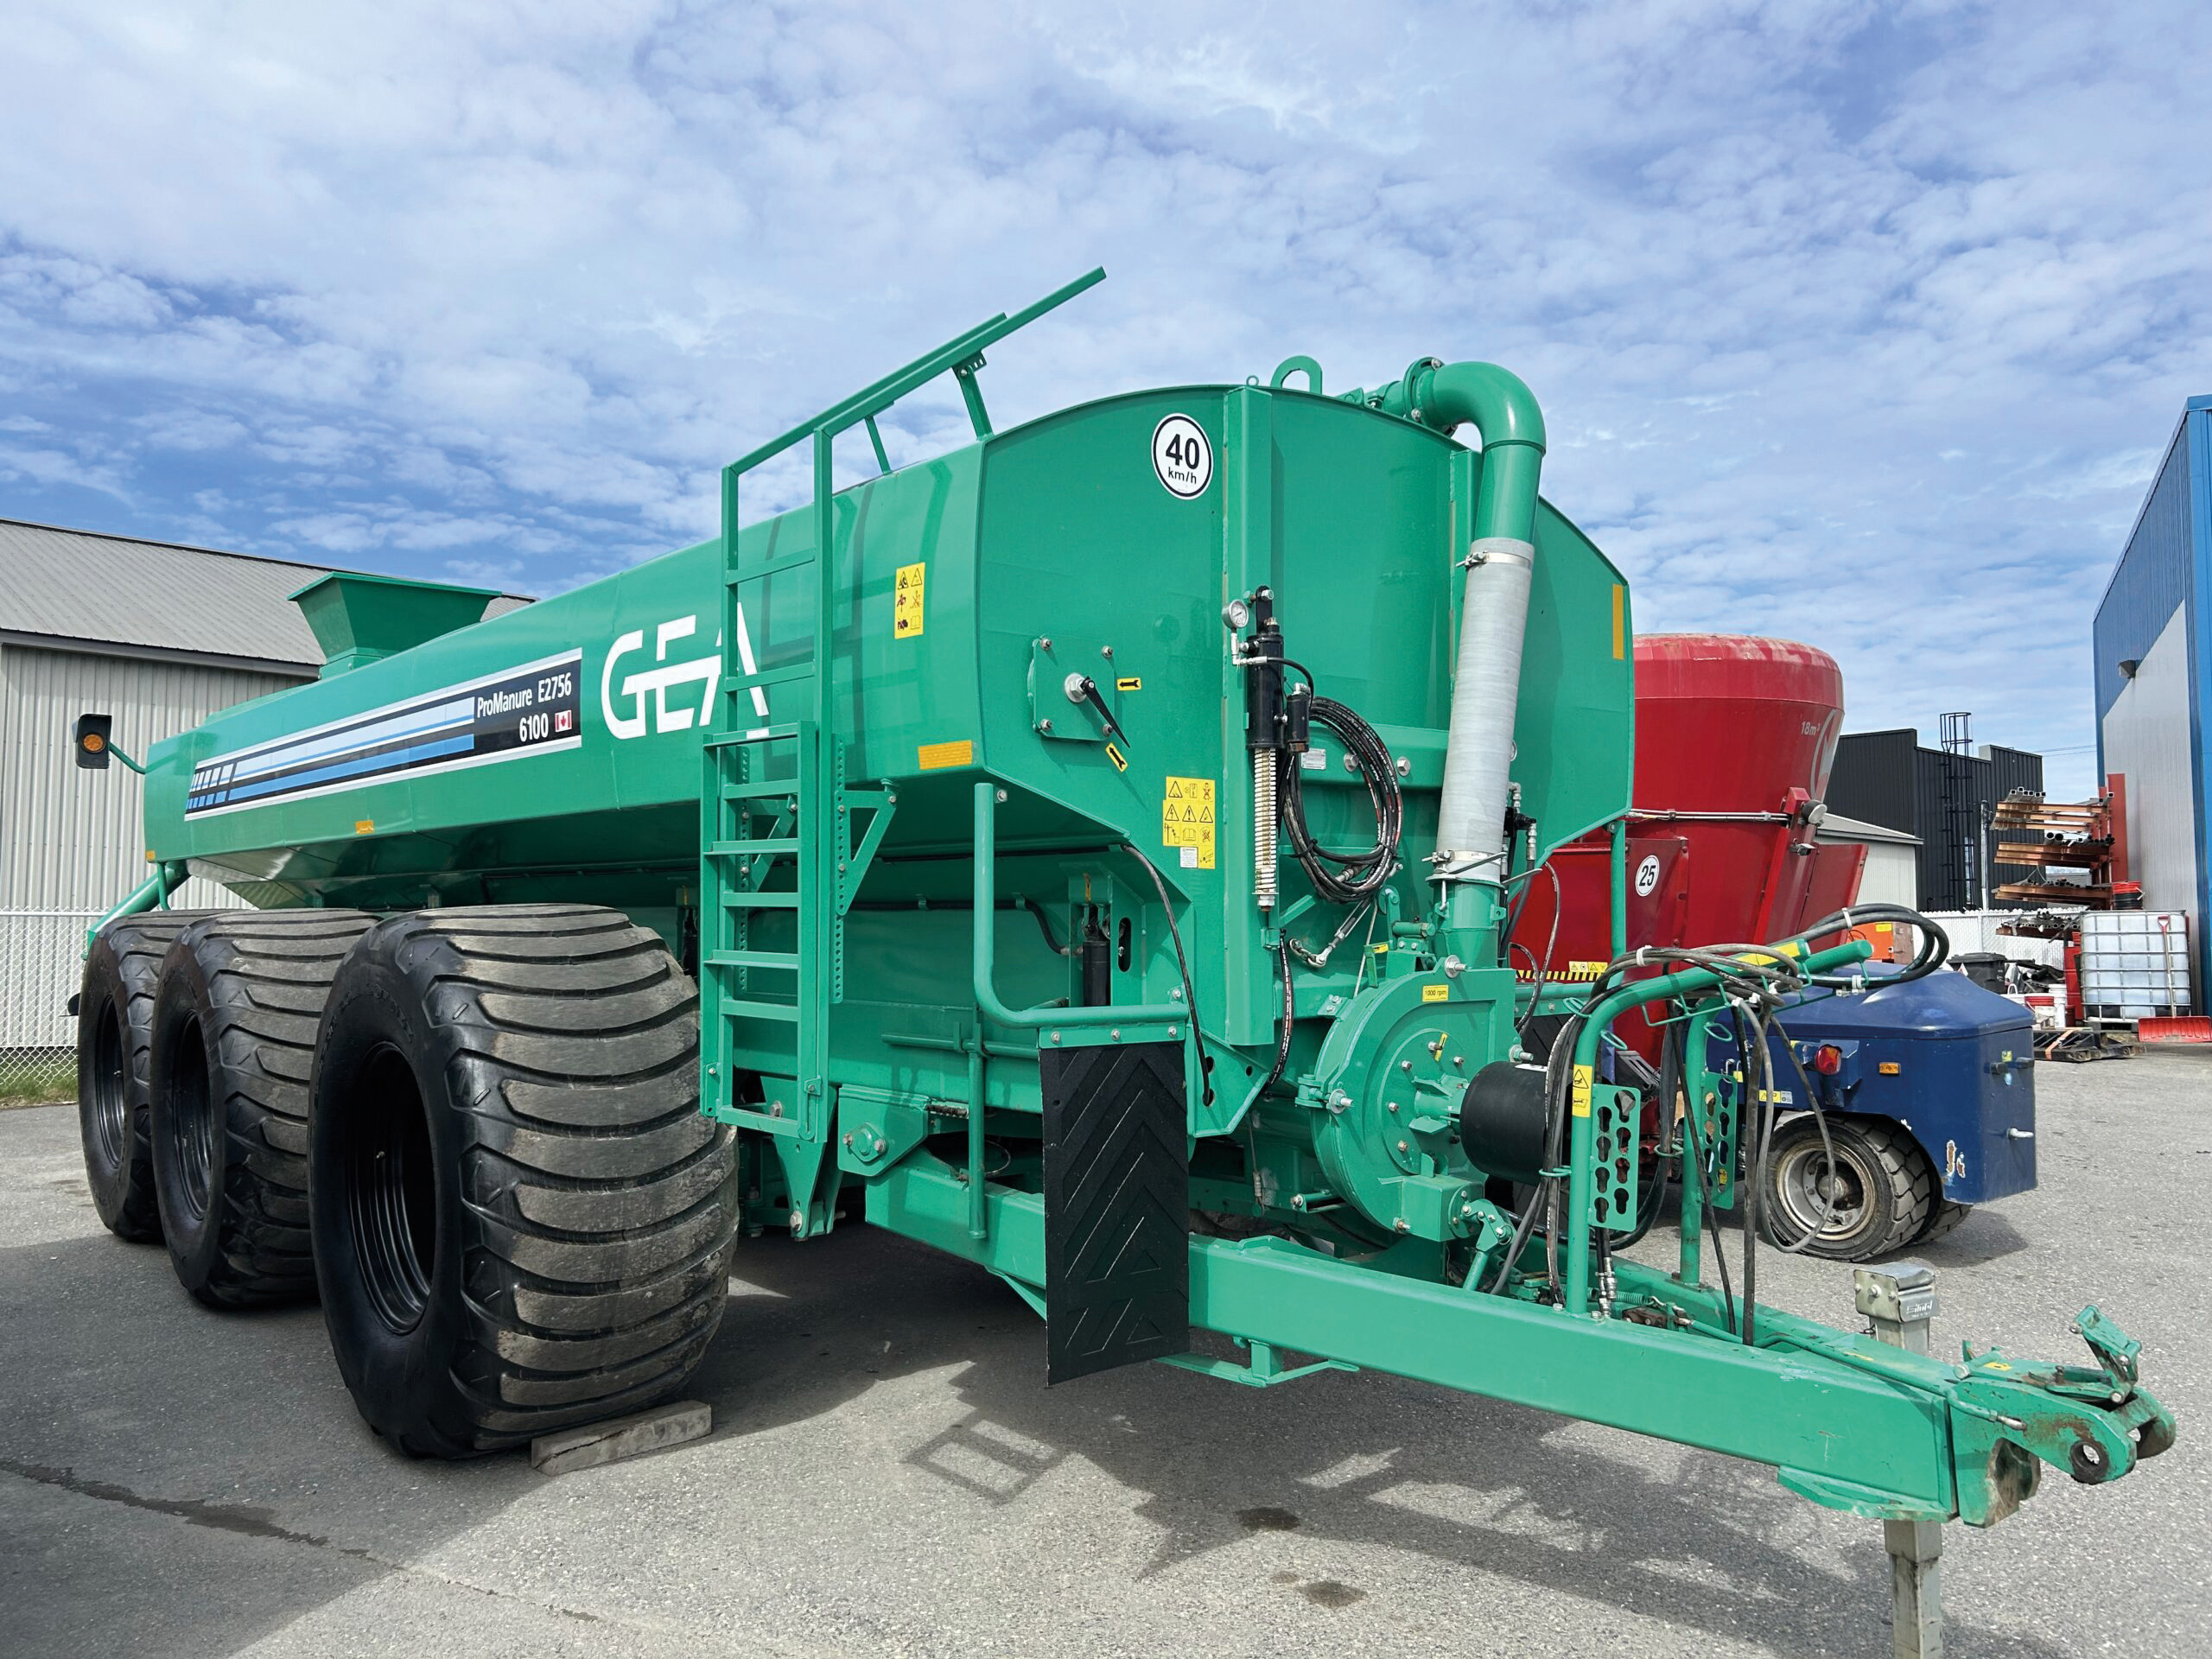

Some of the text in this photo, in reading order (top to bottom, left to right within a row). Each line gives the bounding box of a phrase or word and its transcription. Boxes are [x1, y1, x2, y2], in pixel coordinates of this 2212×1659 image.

[1166, 434, 1200, 469] 40
[1167, 467, 1197, 484] km/h
[601, 601, 769, 741] GEA
[477, 672, 572, 718] ProManure E2756
[519, 712, 549, 742] 6100
[1639, 865, 1656, 887] 25
